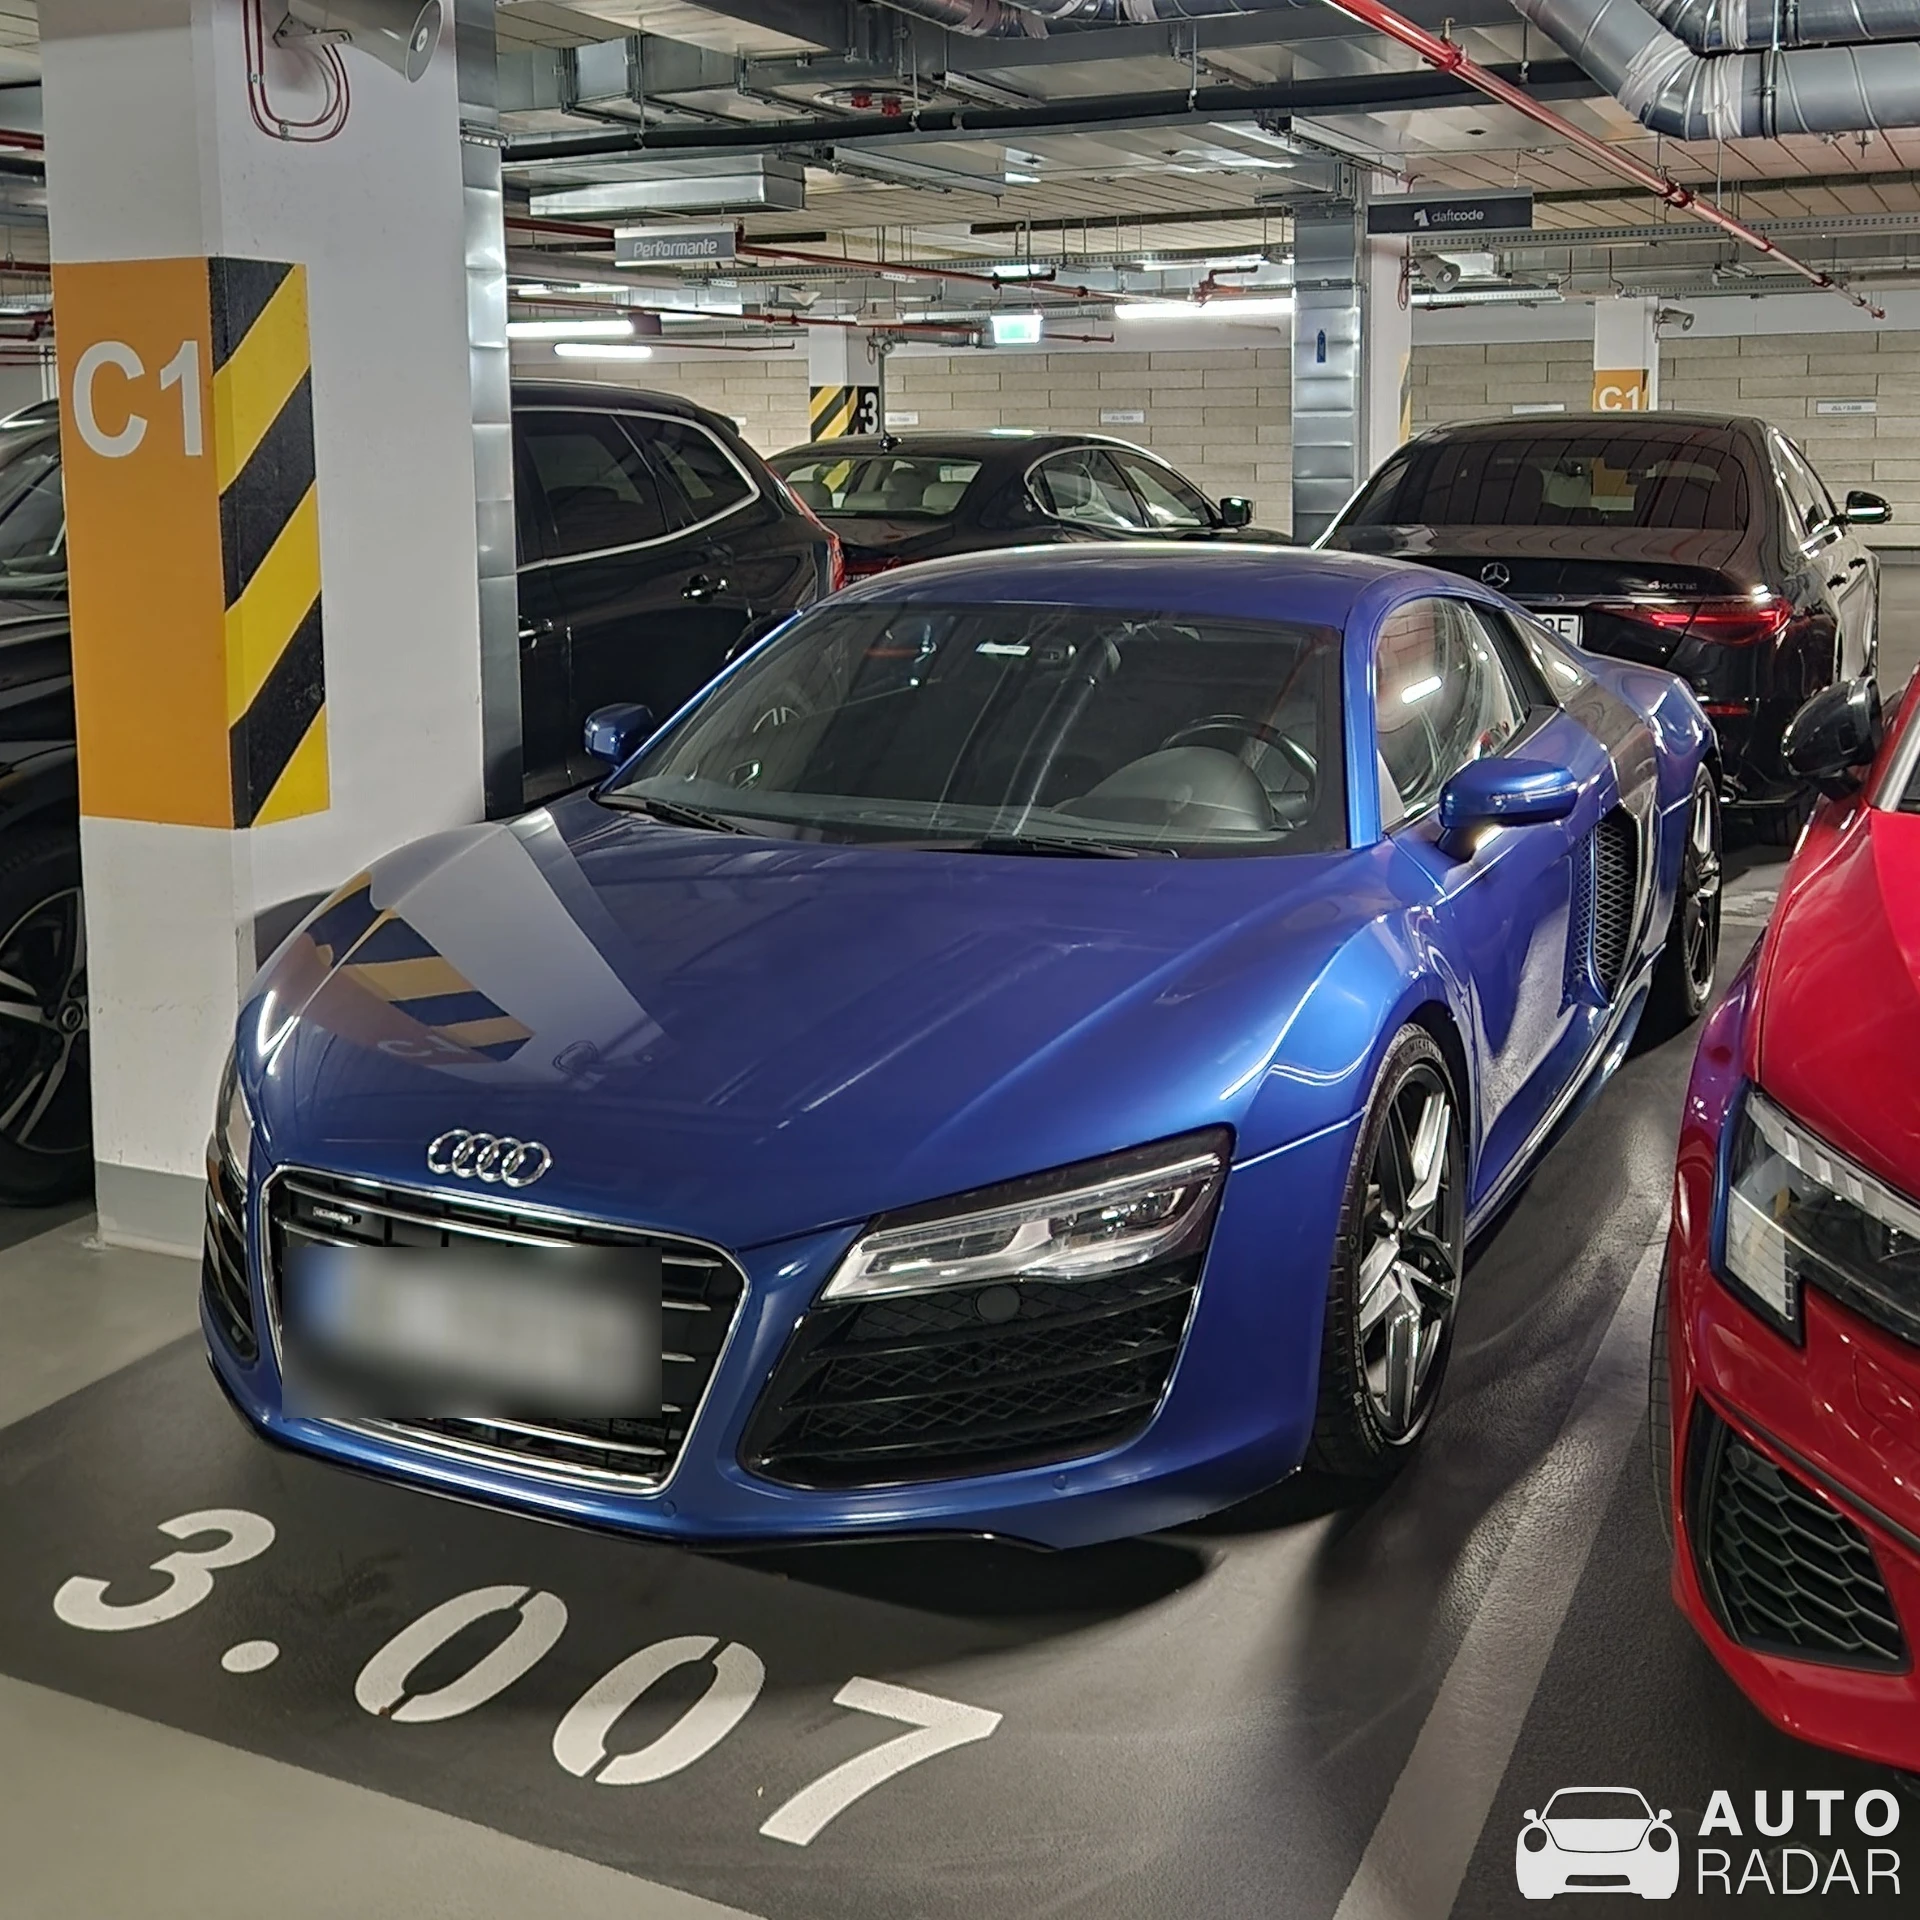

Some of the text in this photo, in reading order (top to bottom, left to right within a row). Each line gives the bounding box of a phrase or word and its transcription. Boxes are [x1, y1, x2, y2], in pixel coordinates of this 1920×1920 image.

[1431, 209, 1485, 223] daftcode
[633, 239, 718, 258] Performante
[73, 340, 203, 458] C1
[1599, 386, 1640, 411] C1
[53, 1508, 1004, 1848] 3.007
